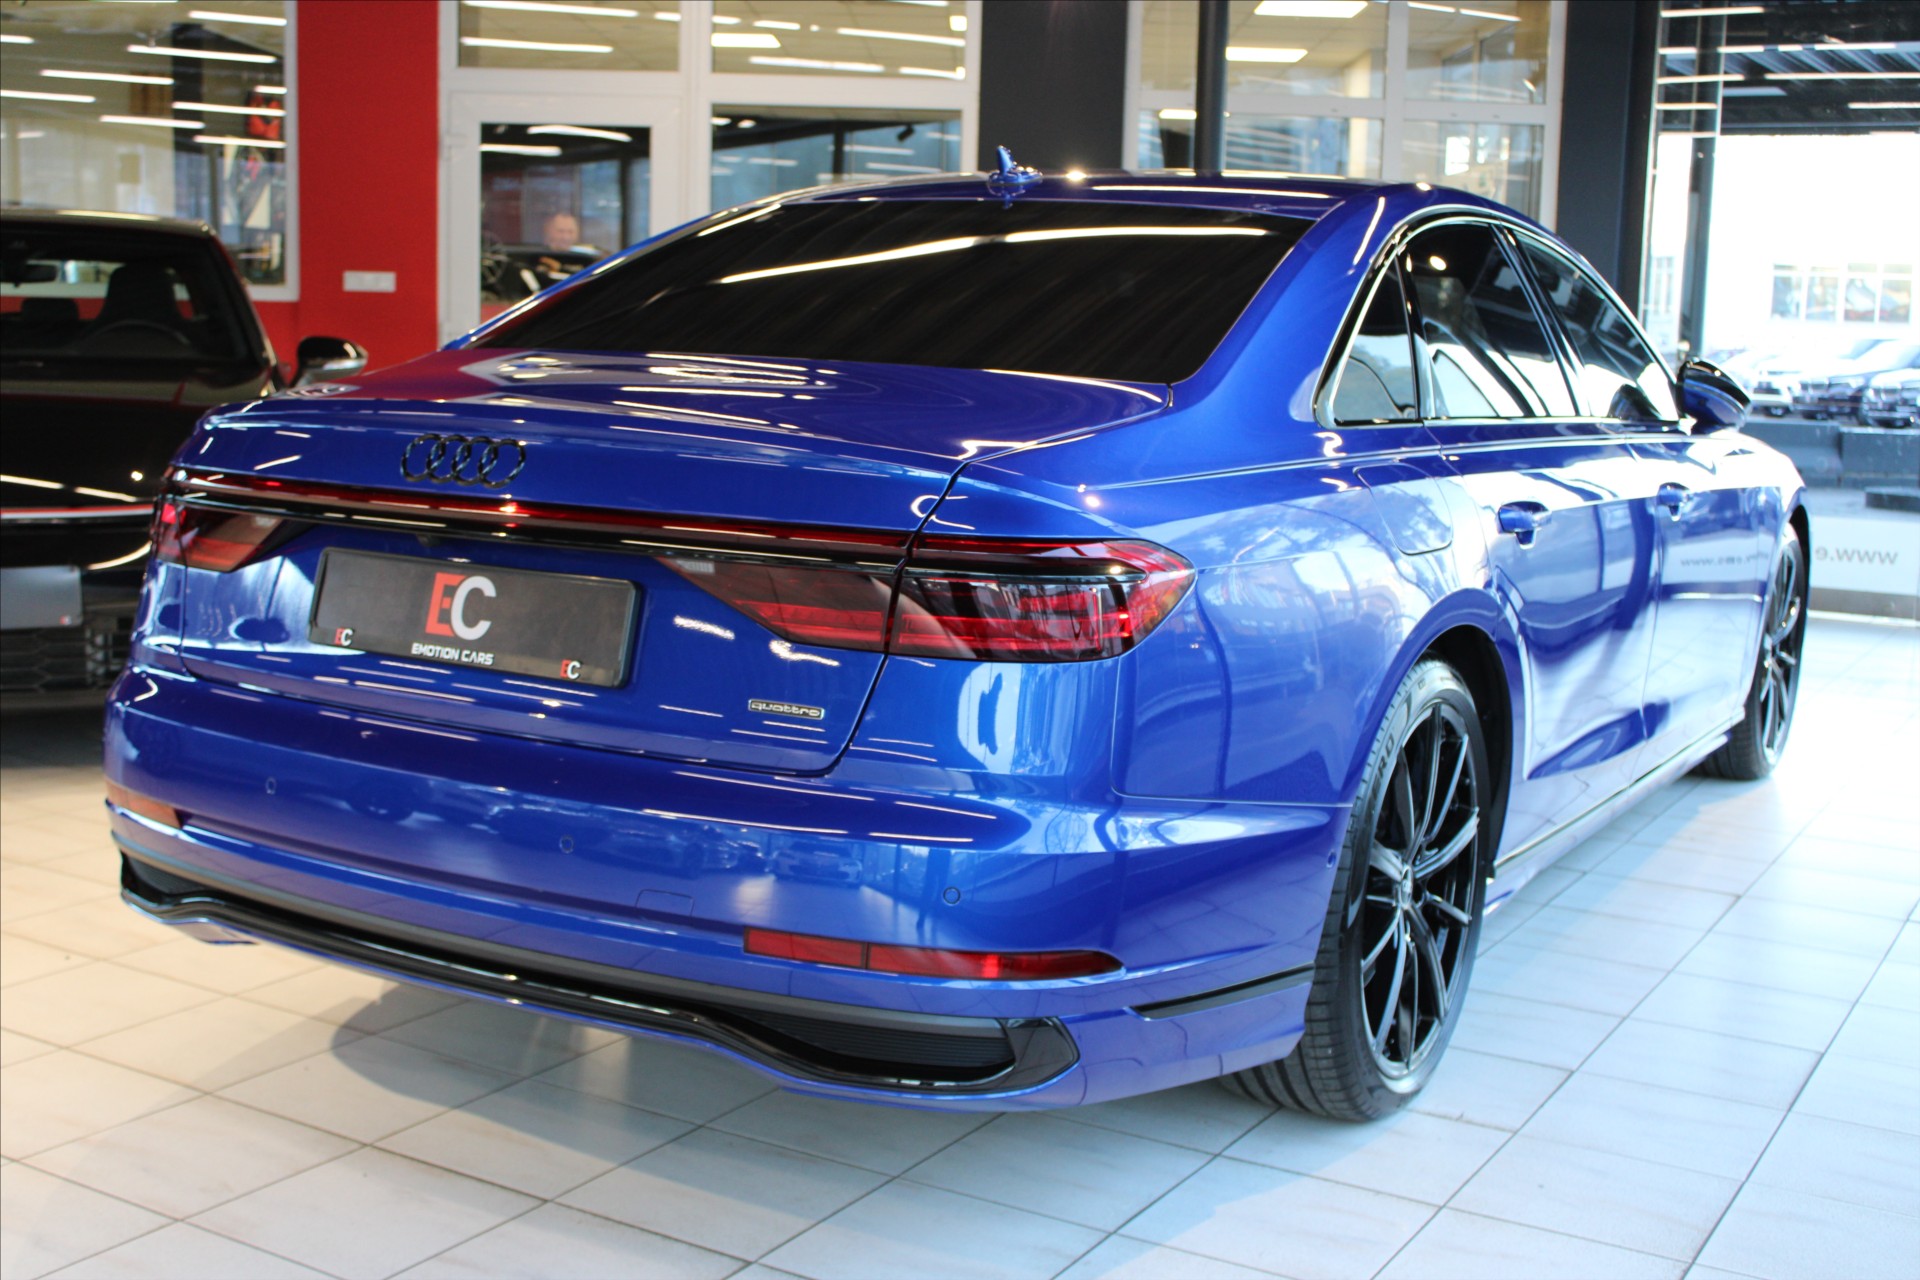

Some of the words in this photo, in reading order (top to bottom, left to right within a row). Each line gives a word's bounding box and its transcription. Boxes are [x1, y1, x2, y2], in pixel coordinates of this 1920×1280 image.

[425, 572, 497, 641] EC
[335, 627, 353, 646] EC
[411, 642, 460, 661] EMOTION
[461, 650, 495, 666] CARS
[560, 659, 581, 679] EC
[751, 701, 821, 717] quattro
